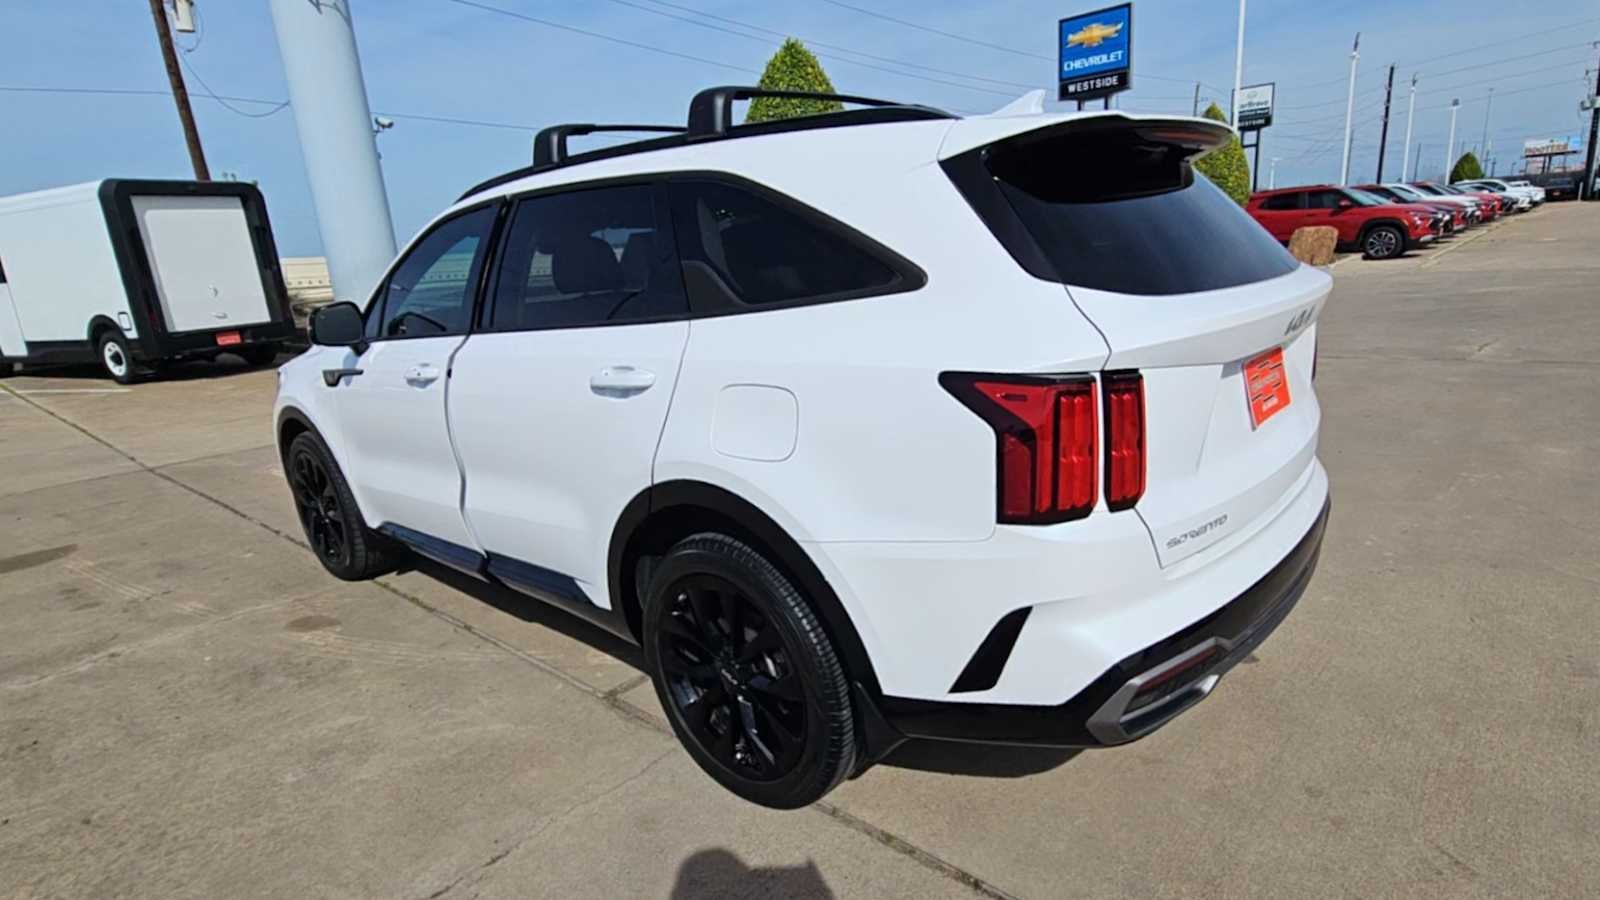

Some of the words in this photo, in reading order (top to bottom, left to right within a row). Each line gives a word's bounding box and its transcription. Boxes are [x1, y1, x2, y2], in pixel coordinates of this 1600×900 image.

[1063, 50, 1124, 72] CHEVROLET
[1067, 75, 1119, 93] WESTSIDE
[1166, 514, 1228, 549] SORENTO
